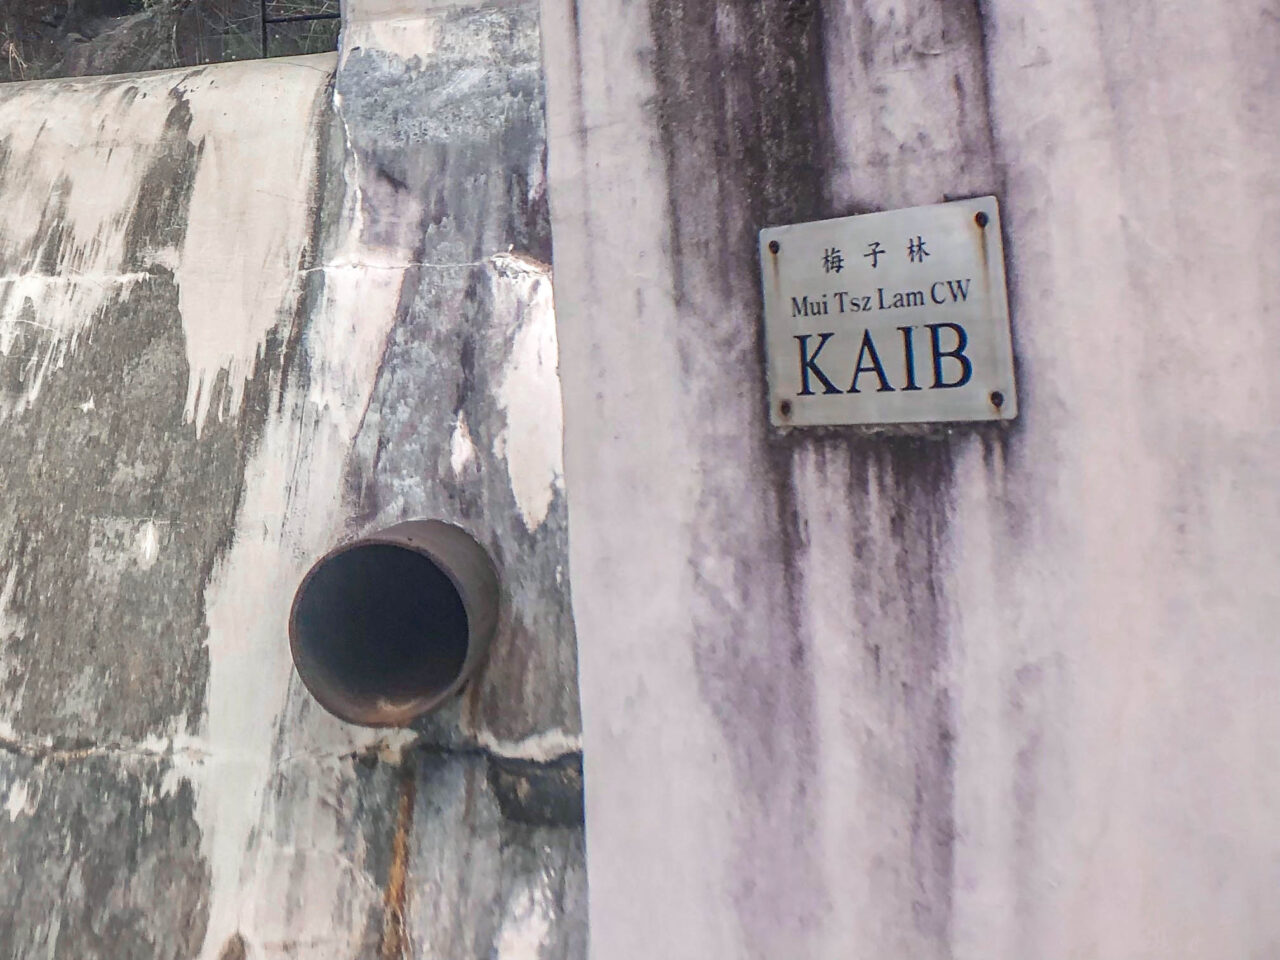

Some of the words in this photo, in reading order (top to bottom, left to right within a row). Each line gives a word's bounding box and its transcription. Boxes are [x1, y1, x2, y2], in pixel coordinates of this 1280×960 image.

[822, 236, 931, 274] 梅子林
[791, 294, 829, 317] Mui
[834, 291, 872, 313] Tsz
[878, 287, 925, 310] Lam
[931, 279, 971, 305] CW
[793, 322, 973, 396] KAIB
